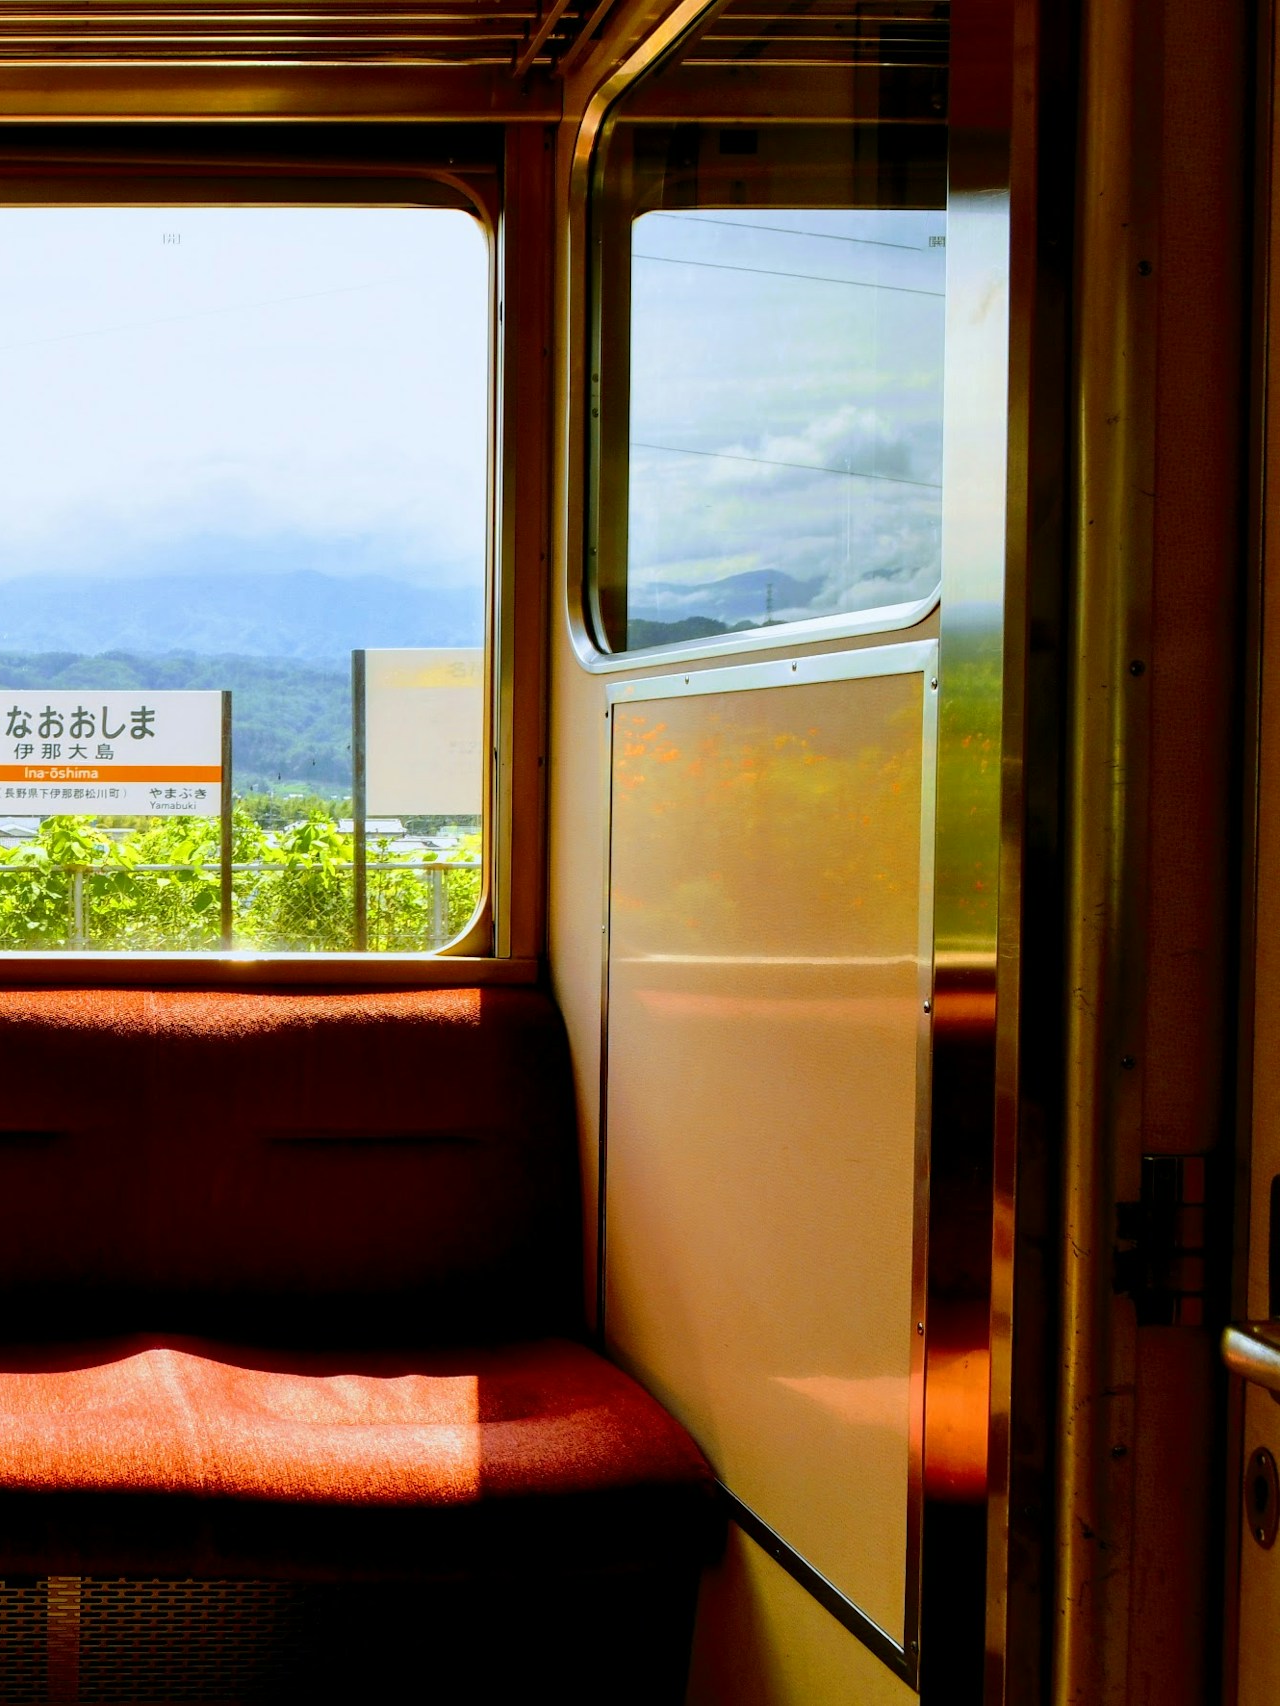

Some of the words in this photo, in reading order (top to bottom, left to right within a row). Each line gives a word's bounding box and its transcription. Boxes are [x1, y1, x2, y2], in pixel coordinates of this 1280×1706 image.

[14, 743, 115, 760] 伊那大島
[149, 788, 207, 799] やまぶき
[149, 801, 197, 810] Yamabuki
